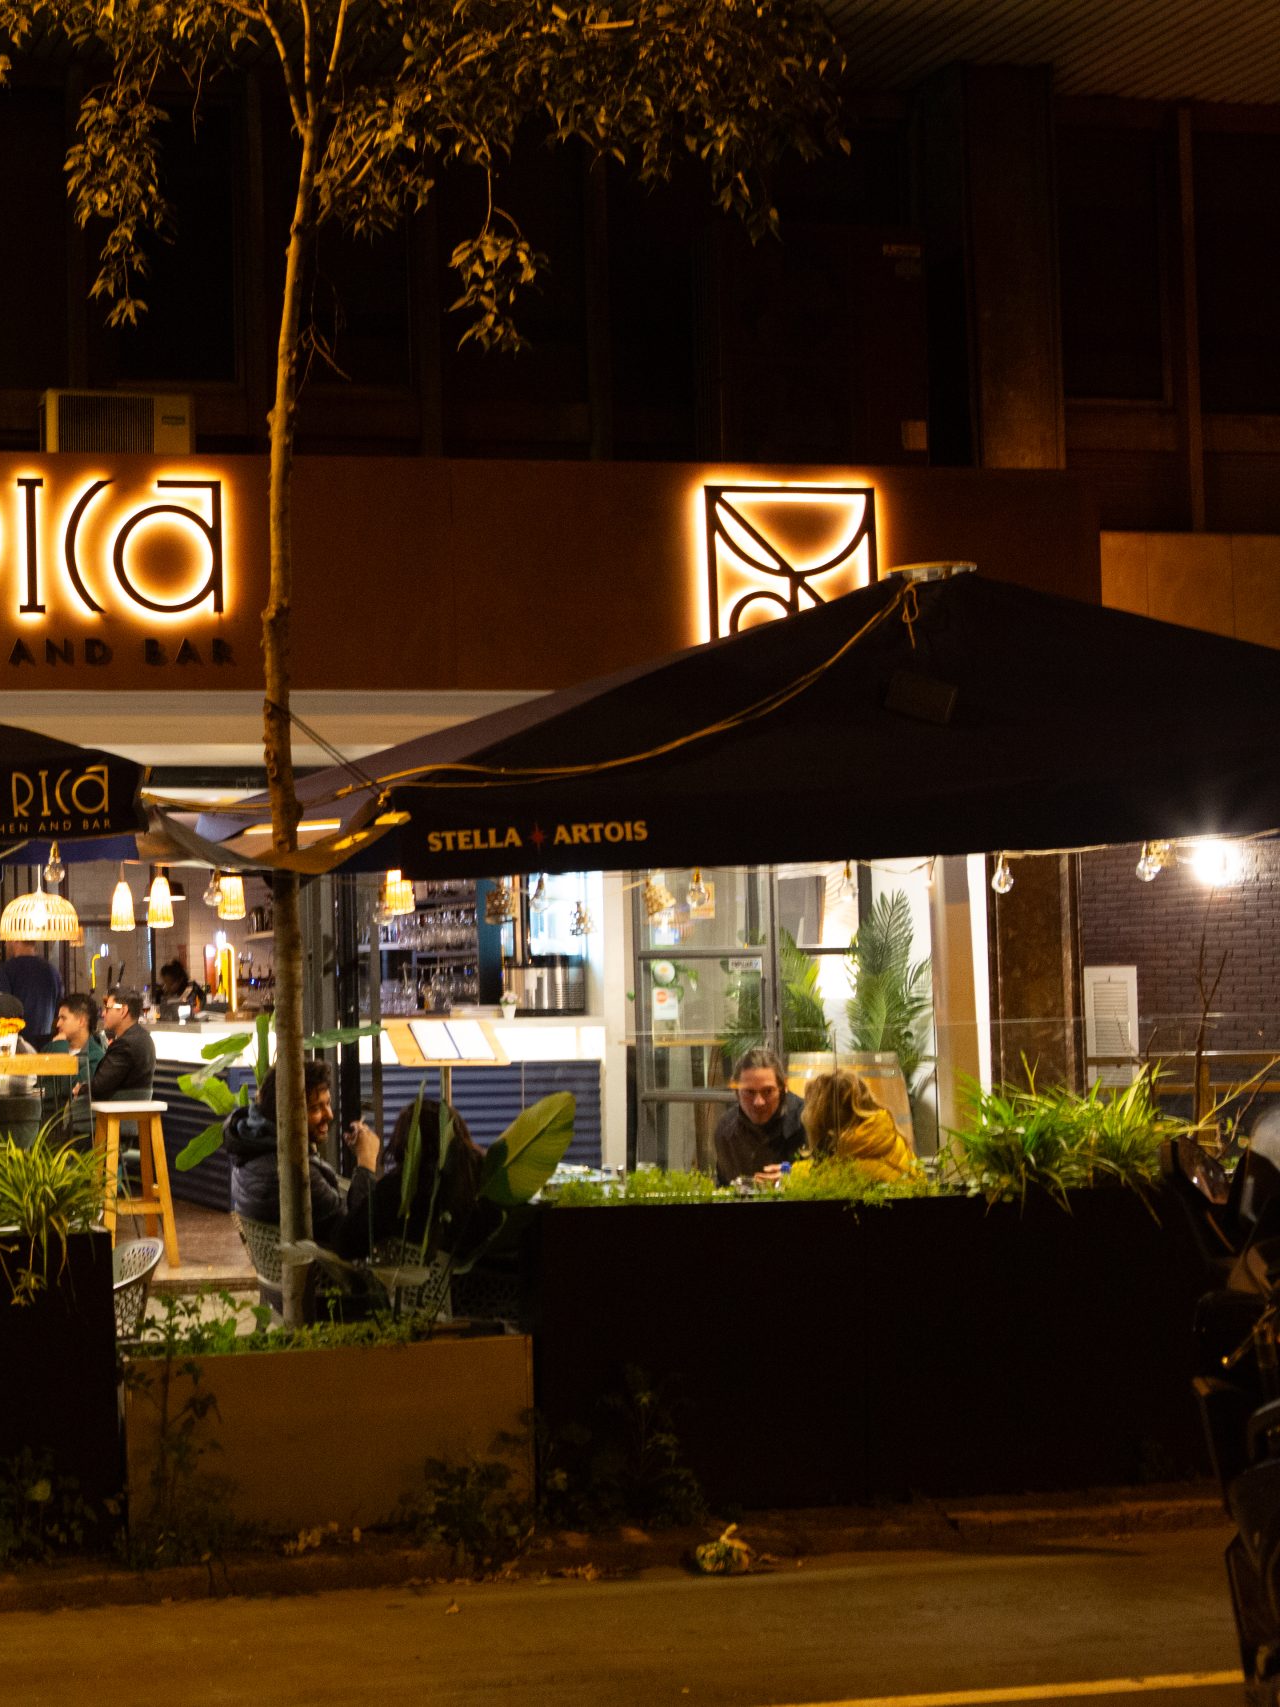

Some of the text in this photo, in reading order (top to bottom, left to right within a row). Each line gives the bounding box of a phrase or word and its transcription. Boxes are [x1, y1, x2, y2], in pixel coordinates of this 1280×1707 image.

[9, 638, 114, 668] AND
[144, 638, 235, 668] BAR
[38, 820, 72, 833] AND
[82, 818, 112, 831] BAR
[427, 820, 649, 852] STELLA ARTOIS
